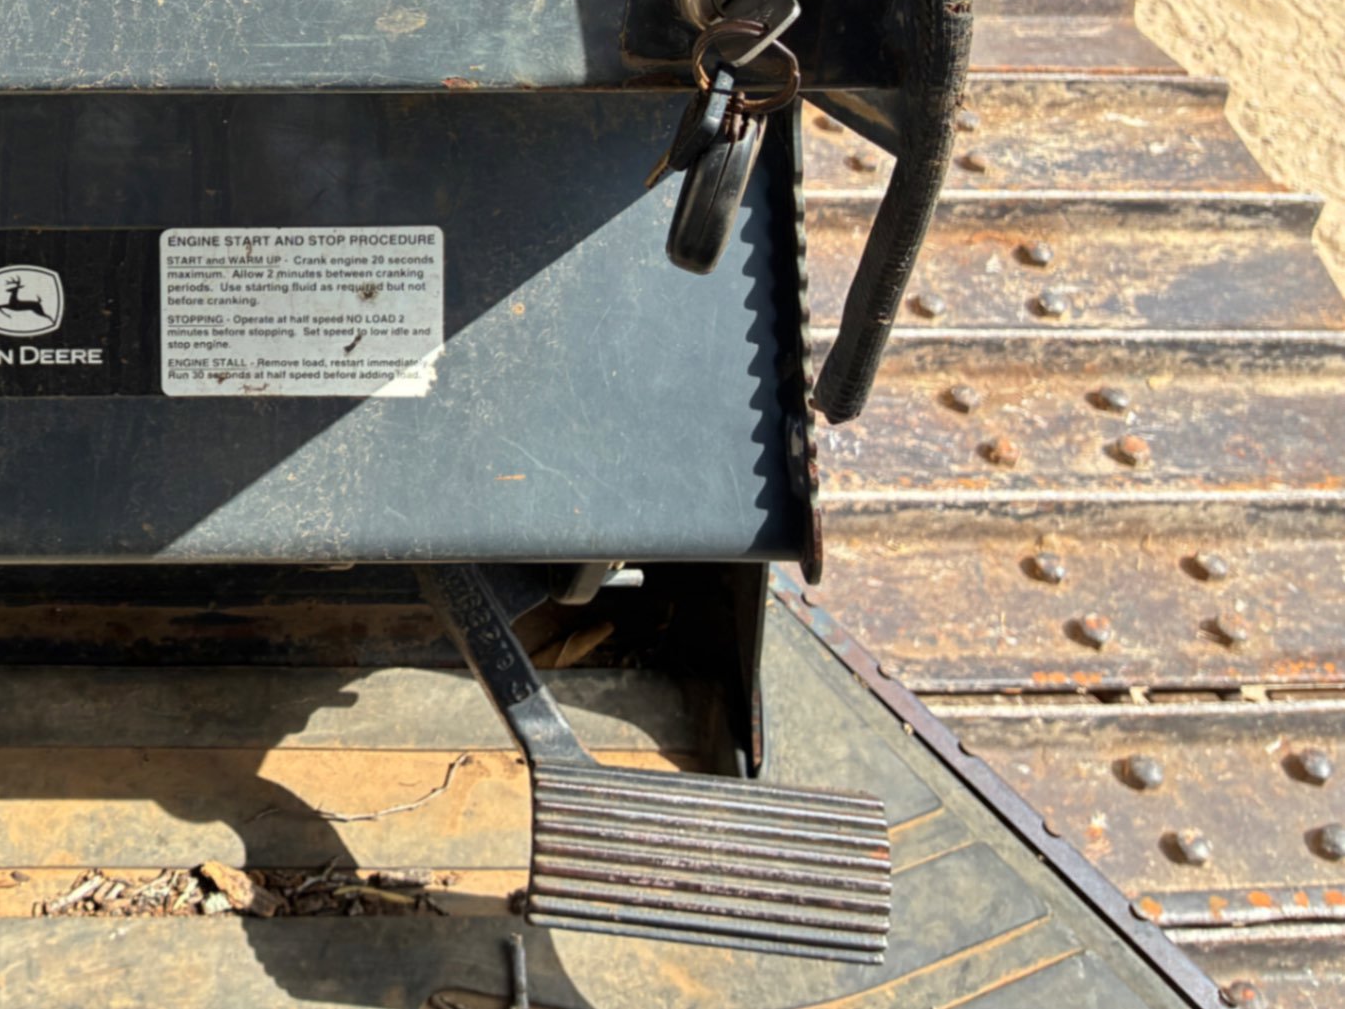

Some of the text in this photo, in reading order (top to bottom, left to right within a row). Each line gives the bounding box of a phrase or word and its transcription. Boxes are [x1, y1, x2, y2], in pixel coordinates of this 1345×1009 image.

[168, 235, 435, 247] ENGINE START AND STOP PROCEDURE
[168, 256, 202, 265] START
[206, 256, 224, 264] and
[228, 256, 263, 264] WARM
[267, 256, 281, 264] UP
[294, 256, 326, 264] Crank
[331, 256, 368, 266] engine
[372, 256, 384, 264] 20
[388, 255, 434, 264] seconds
[168, 269, 424, 279] maximum. Allow 2 minutes between cranking
[168, 283, 213, 293] periods.
[220, 283, 241, 291] Use
[245, 283, 288, 293] starting
[292, 283, 317, 291] fluid
[168, 297, 260, 307] before cranking.
[168, 315, 223, 323] STOPPING
[233, 315, 273, 325] Operate
[290, 315, 309, 323] half
[312, 315, 343, 325] speed
[347, 315, 362, 323] NO
[366, 315, 395, 323] LOAD
[398, 315, 404, 323] 2
[168, 328, 209, 336] minutes
[212, 328, 245, 336] before
[248, 328, 297, 338] stopping.
[304, 328, 320, 336] Set
[324, 328, 354, 338] speed
[392, 327, 409, 335] idle
[412, 327, 431, 335] and
[168, 340, 230, 350] stop engine.
[20, 346, 103, 365] DEERE
[168, 359, 209, 367] ENGINE
[213, 359, 246, 367] STALL
[258, 359, 299, 367] Remove
[302, 359, 327, 368] load,
[331, 359, 364, 367] restart
[168, 371, 189, 380] Run
[193, 371, 204, 379] 30
[254, 371, 264, 379] at
[267, 371, 285, 379] half
[289, 371, 321, 381] speed
[324, 371, 356, 379] before
[360, 371, 394, 381] adding
